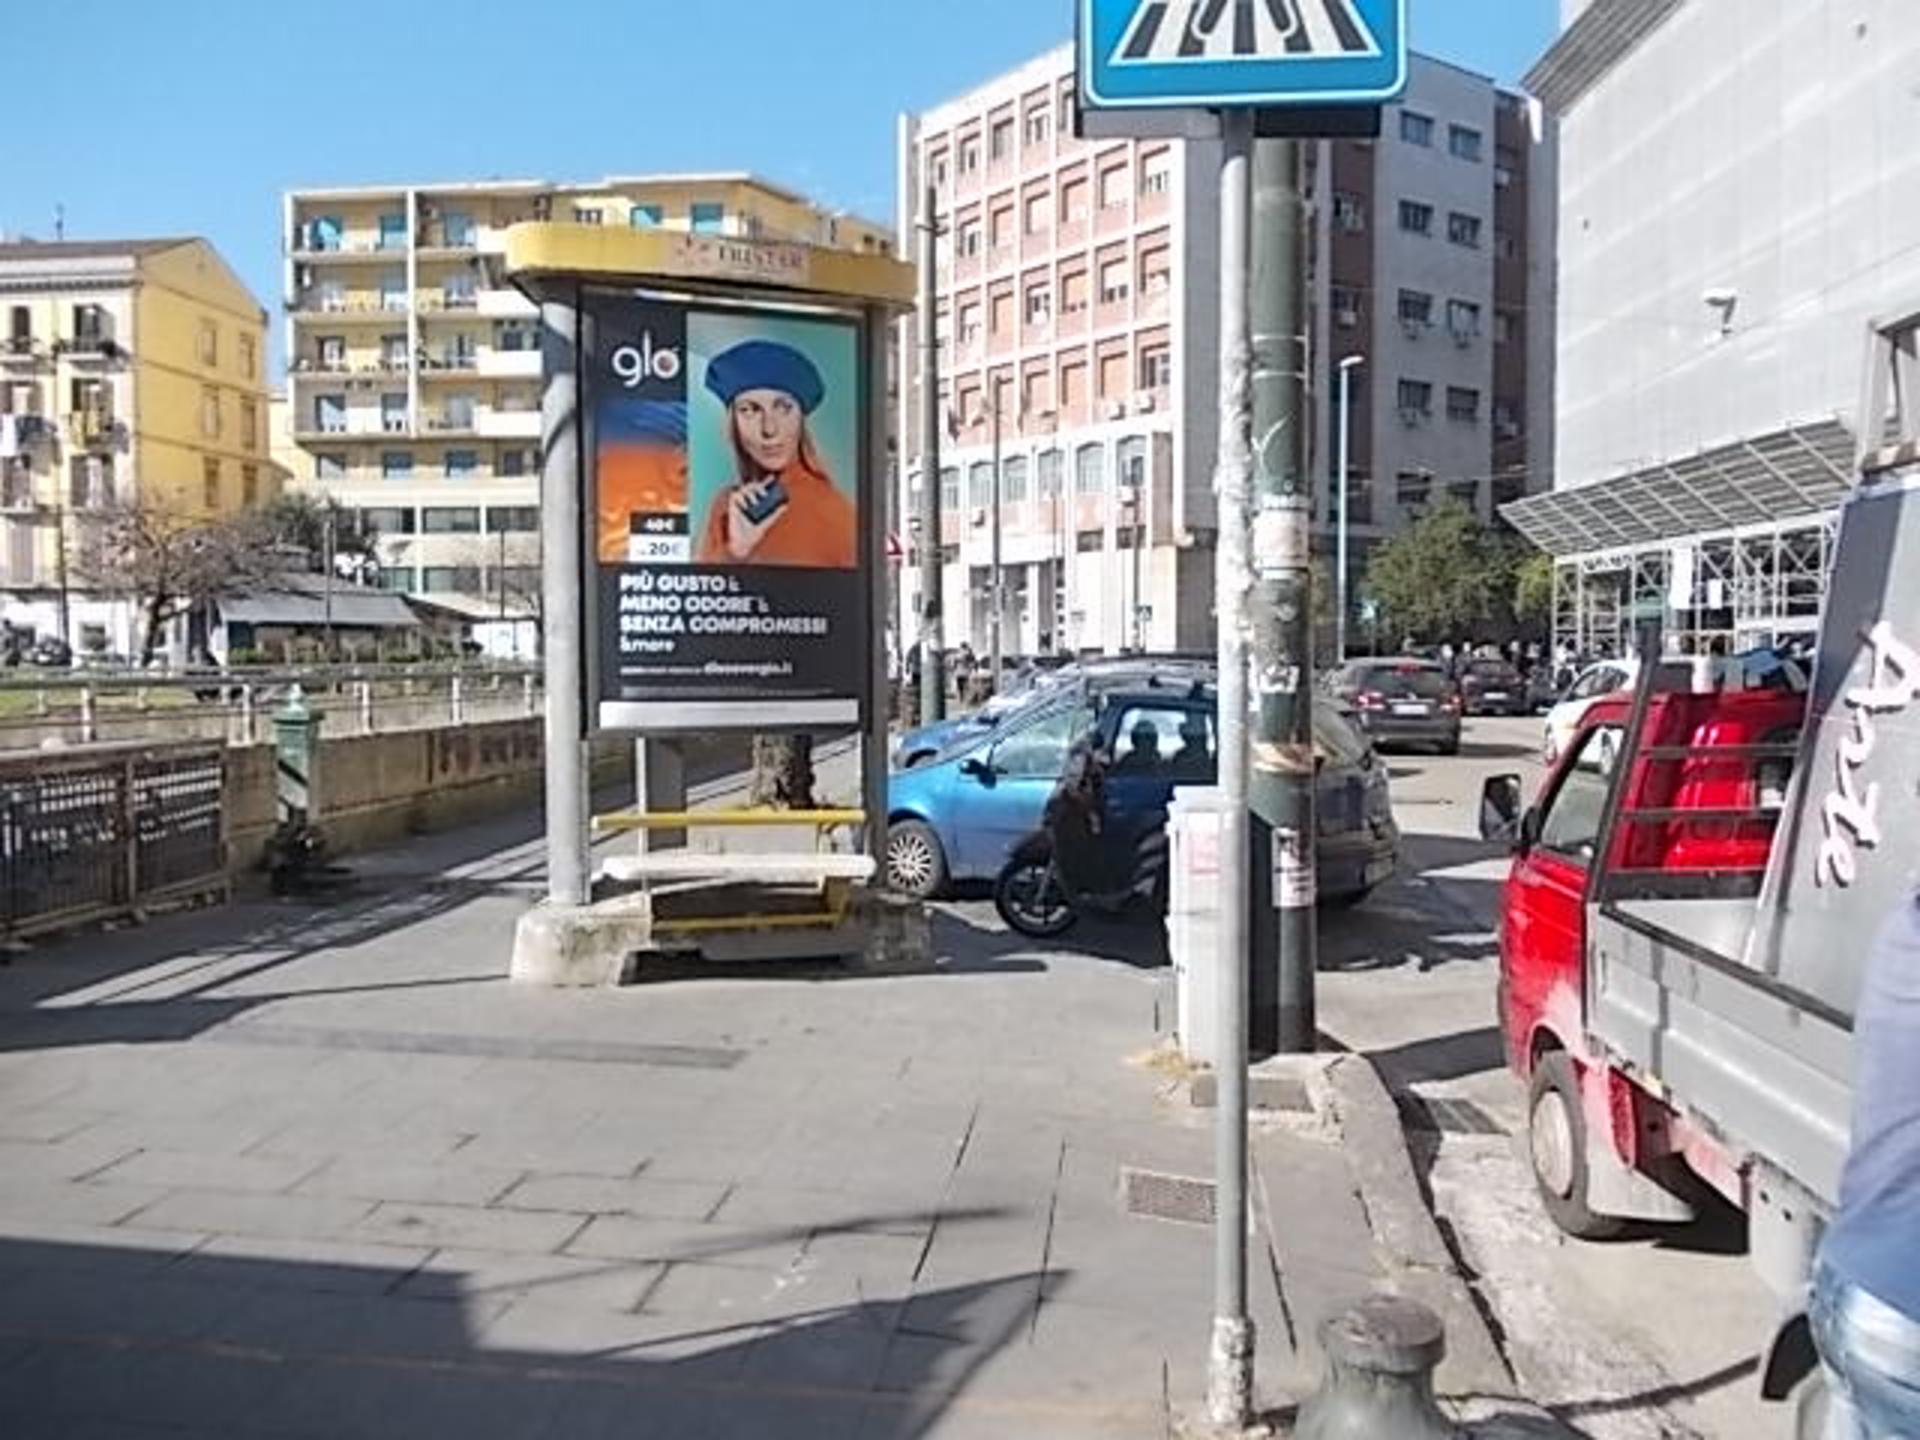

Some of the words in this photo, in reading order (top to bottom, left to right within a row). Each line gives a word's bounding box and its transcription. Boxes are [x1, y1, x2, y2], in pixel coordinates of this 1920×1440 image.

[612, 329, 681, 388] glo
[620, 570, 653, 591] PIÙ
[657, 575, 726, 591] GUSTO
[620, 595, 681, 612] MENO
[619, 615, 686, 633] SENZA
[688, 616, 828, 634] COMPROMESSI
